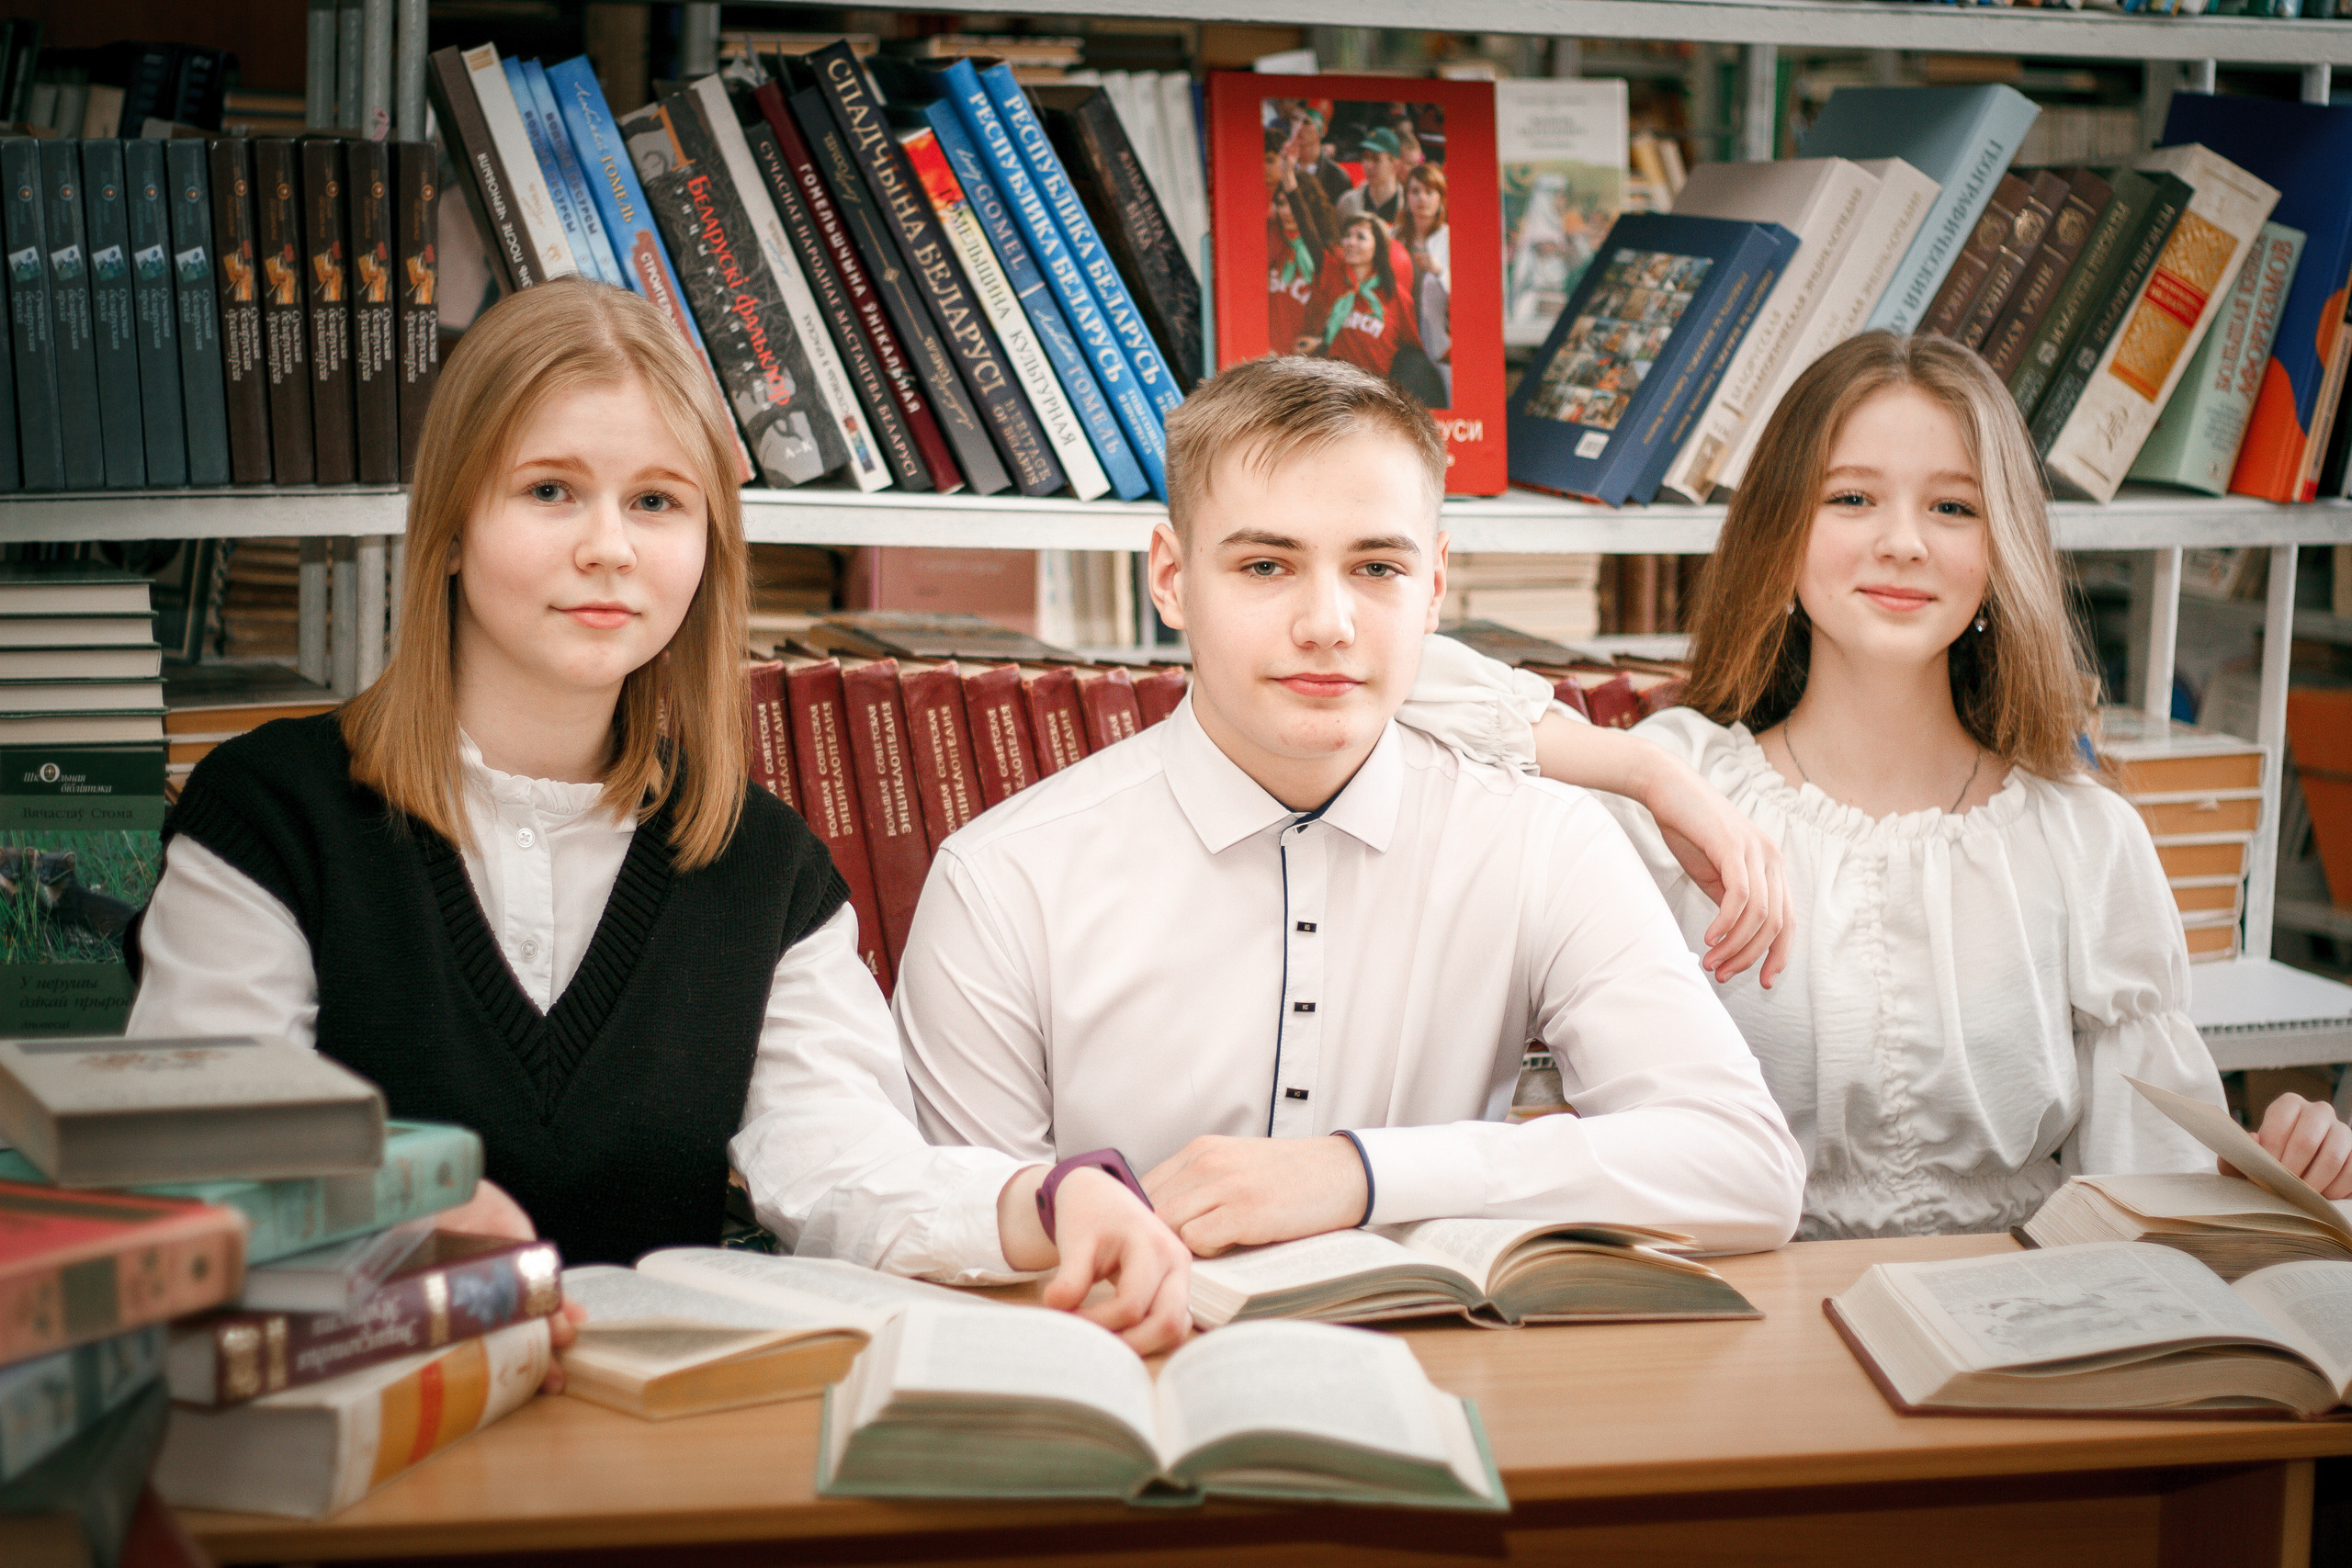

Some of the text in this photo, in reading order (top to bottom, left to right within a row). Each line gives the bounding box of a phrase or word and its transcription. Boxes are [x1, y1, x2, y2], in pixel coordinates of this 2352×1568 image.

[524, 110, 551, 167] ВОДНЫЕ
[548, 172, 576, 233] РЕСУРСЫ
[546, 112, 597, 235] ВОДНЫЕ РЕСУРСЫ
[650, 104, 696, 173] 1
[823, 132, 850, 174] GOMEL
[477, 152, 534, 288] ЗНЬ ПОСЛЕ ЧЕРНОБЫЛЯ
[600, 154, 636, 224] ГОМЕЛЬ
[798, 162, 867, 299] ГОМЕЛЬШЧЫНА
[827, 57, 1007, 397] СПАДЧЫНА БЕЛАРУСІ
[968, 91, 1125, 384] РЕСПУБЛИКА БЕЛАРУСЬ
[974, 184, 1027, 272] GOMEL
[1904, 138, 2005, 310] ГЕОГРАФИЧЕСКИЙ
[1002, 95, 1161, 386] РЕСПУБЛИКА БЕЛАРУСЬ
[2094, 202, 2176, 344] РЕГИОНЫ БЕЛАРУСИ
[759, 140, 918, 478] СУЧАСНАЕ НАРОДНАЕ МАСТАЦТВА БЕЛАРУСІ
[802, 314, 827, 366] КРАСКАХ
[1939, 267, 1974, 322] ЯНКА
[1964, 263, 2014, 349] ЯНКА КУ
[1991, 262, 2055, 369] ЯНКА КУПА
[2051, 267, 2095, 345] БЕЛАРУСИ
[2238, 239, 2293, 400] АФОРИЗМОВ
[923, 336, 954, 387] ГОМЕЛЬ
[1009, 329, 1078, 446] КУЛЬТУРНАЯ
[1068, 364, 1121, 455] ГОМЕЛЬ
[992, 405, 1041, 487] OF BELARUS
[1005, 397, 1053, 481] HERITAGE
[757, 702, 774, 775] СОВЕТСКАЯ
[770, 700, 794, 808] ИКЛОПЕДИЯ
[809, 704, 840, 839] БОЛЬШАЯ СОВЕТСКАЯ
[822, 700, 854, 836] ЭНЦИКЛОПЕДИЯ
[867, 704, 898, 838] БОЛЬШАЯ СОВЕТСКАЯ
[881, 700, 913, 834] ЭНЦИКЛОПЕДИЯ
[926, 708, 957, 834] ОЛЬШАЯ СОВЕТСКАЯ
[941, 705, 970, 826] НЦИКЛОПЕДИЯ
[987, 707, 1009, 778] СОВЕТСКАЯ
[1000, 704, 1026, 790] КЛОПЕДИЯ
[1046, 711, 1068, 772] ОВЕТСКАЯ
[23, 807, 132, 821] Вячаслаў Стома
[61, 783, 112, 794] бібліятэка
[19, 976, 97, 992] У нерушы
[20, 995, 133, 1010] дзікай прырод
